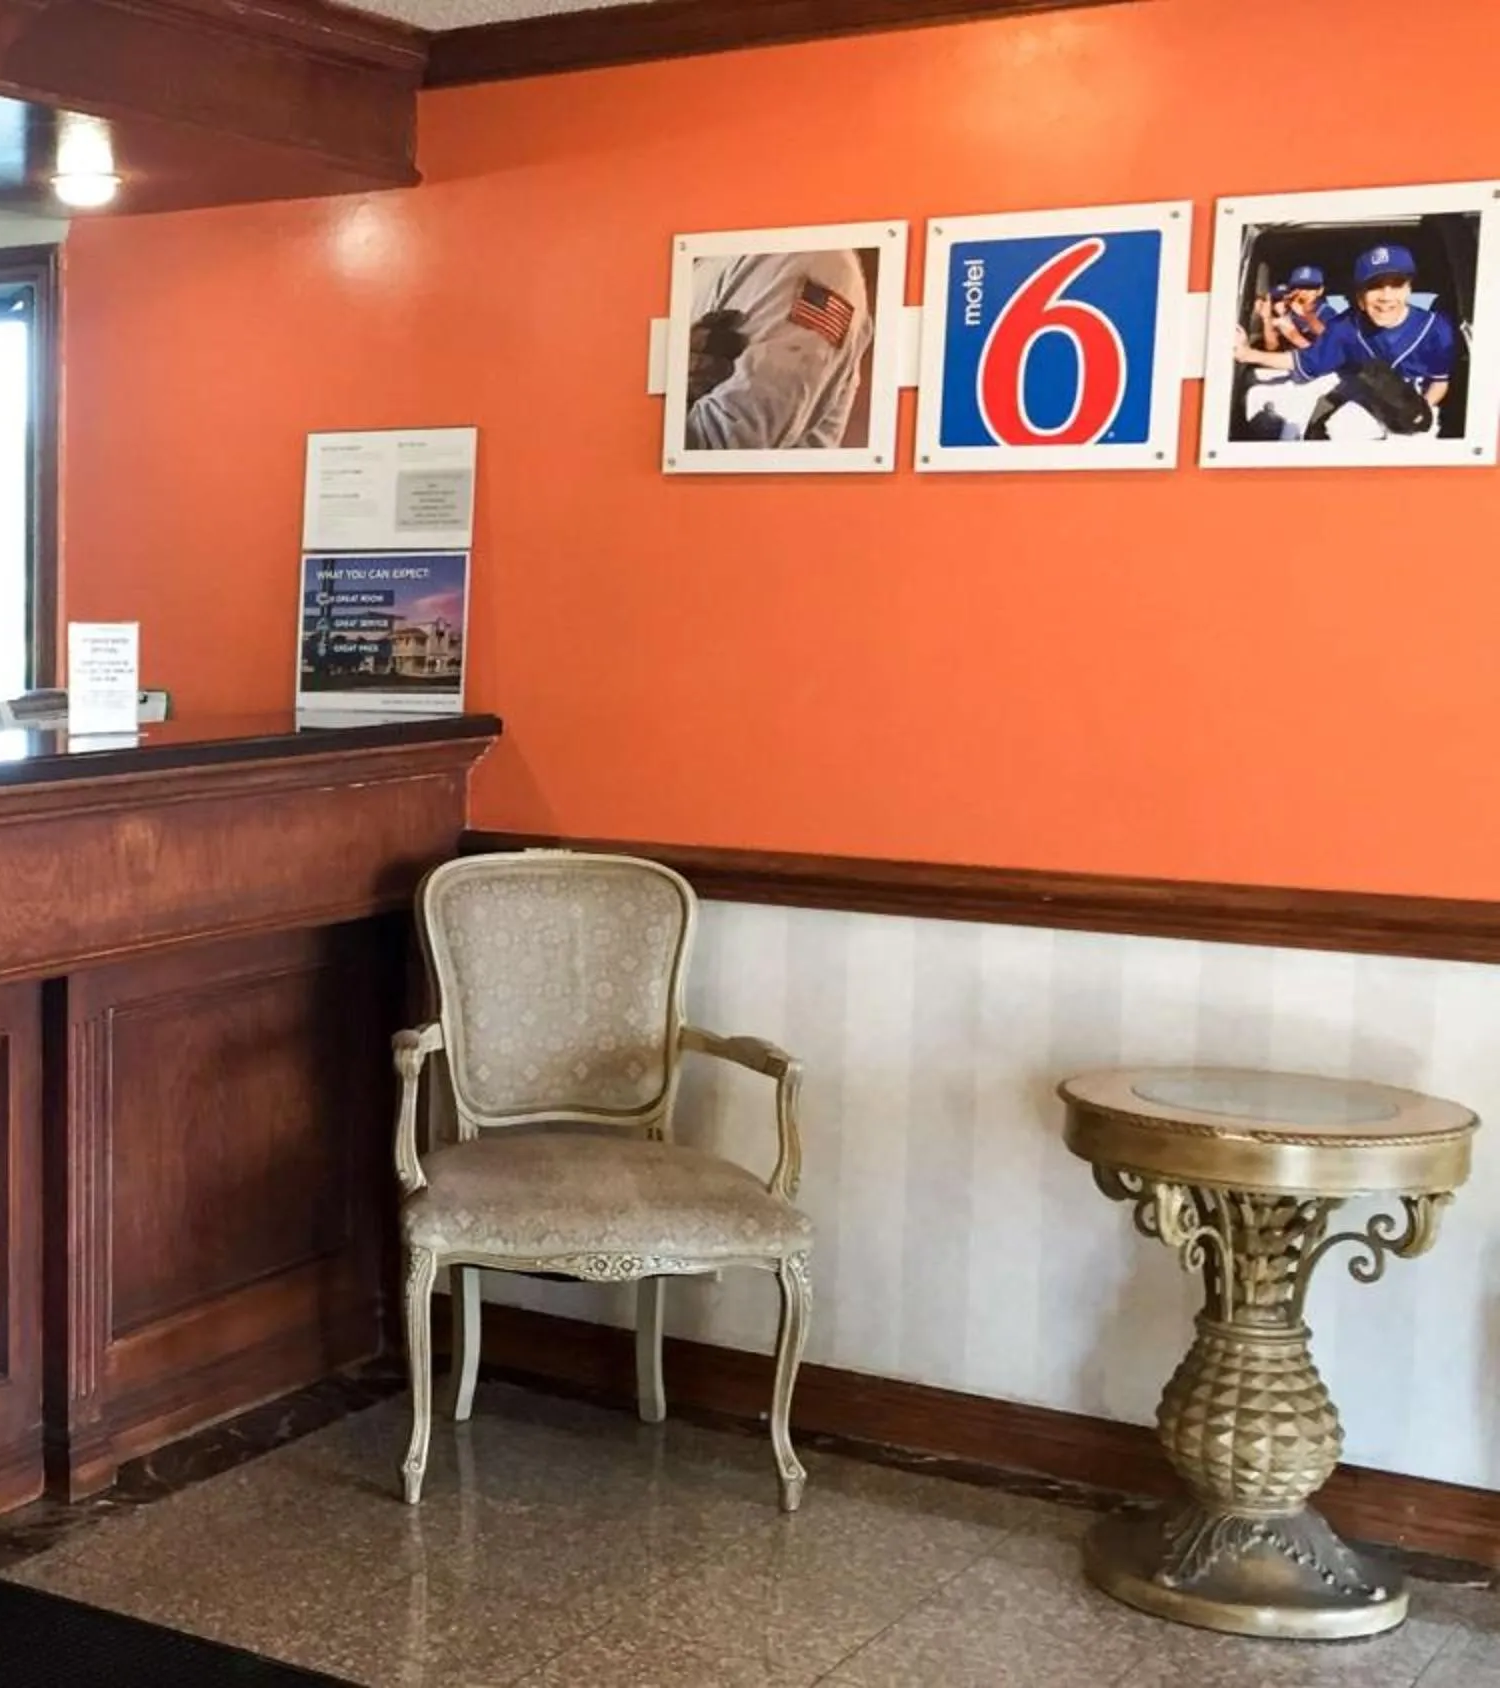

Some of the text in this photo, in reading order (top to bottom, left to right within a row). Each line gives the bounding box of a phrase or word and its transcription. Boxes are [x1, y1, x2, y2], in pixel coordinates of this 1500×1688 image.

[963, 237, 1128, 447] motel 6
[316, 570, 344, 581] WHAT
[346, 570, 367, 580] YOU
[368, 569, 389, 579] CAN
[335, 594, 384, 603] GREAT ROOM
